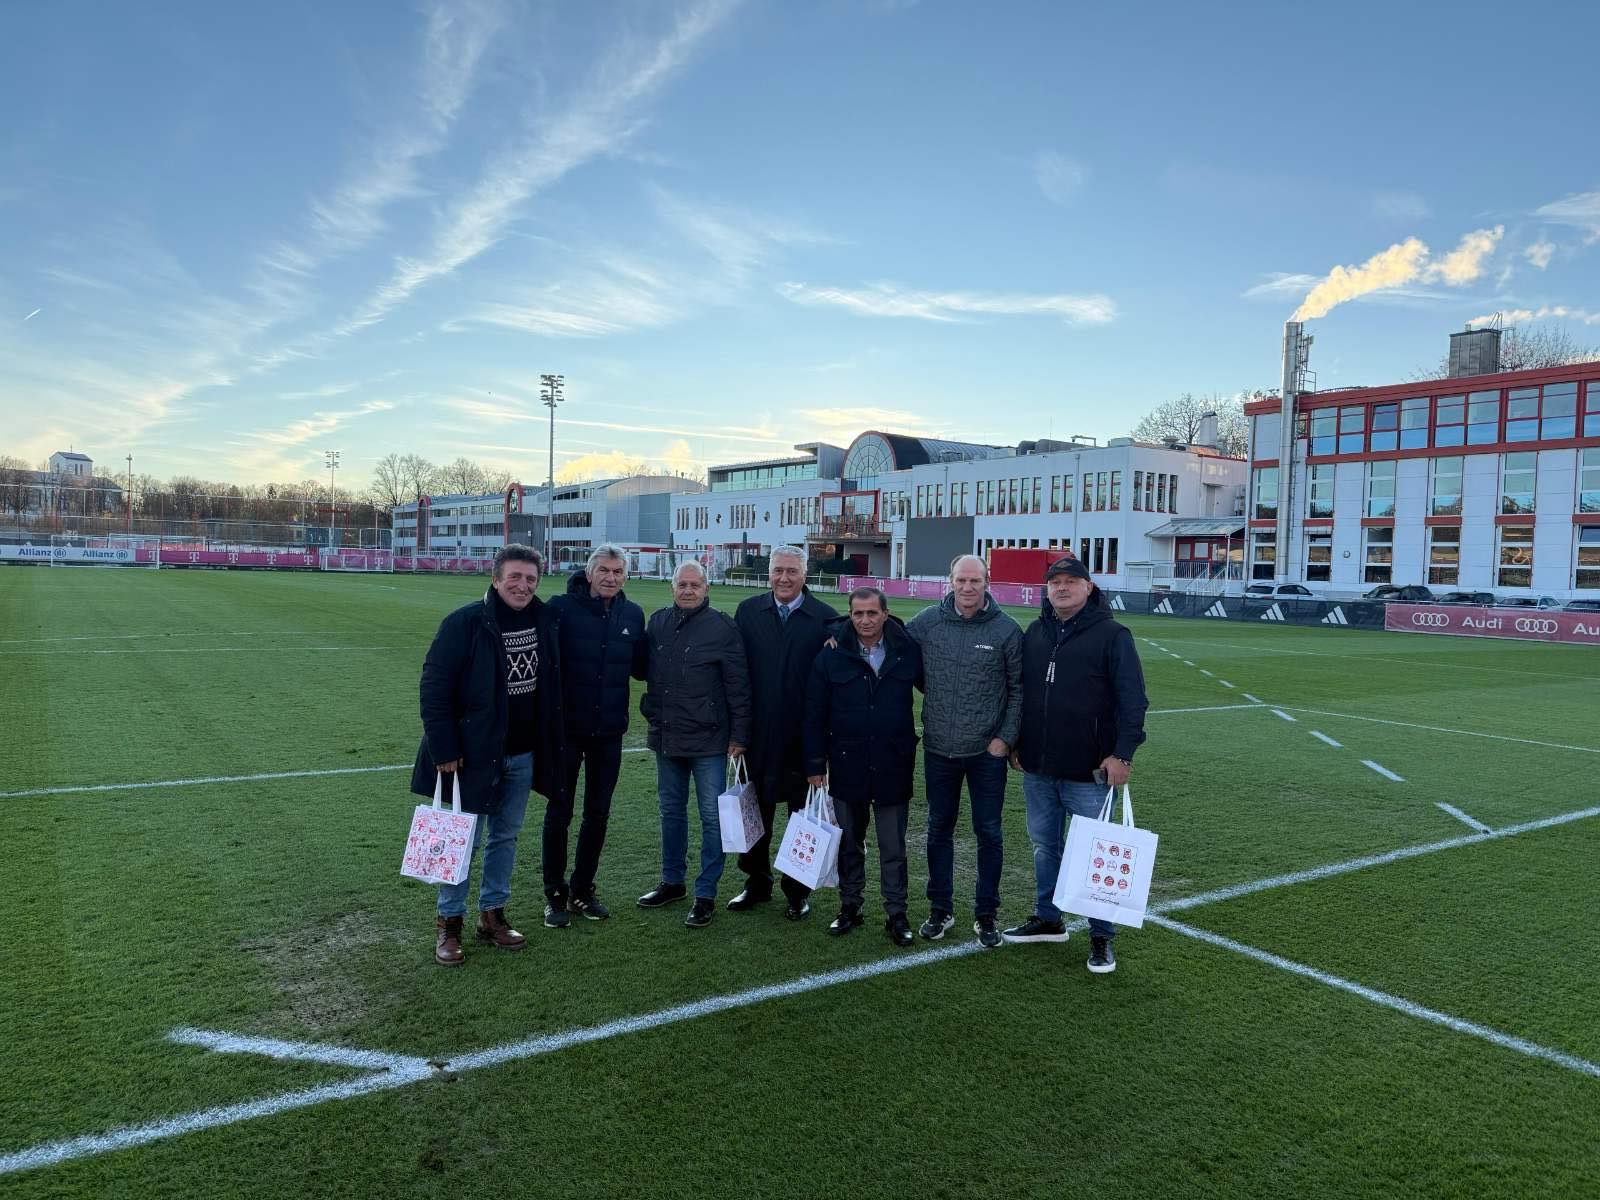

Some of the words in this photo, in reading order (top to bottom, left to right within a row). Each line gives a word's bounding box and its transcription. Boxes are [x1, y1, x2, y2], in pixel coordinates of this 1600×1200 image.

[18, 548, 51, 556] Allianz
[82, 549, 114, 558] Allianz
[189, 552, 199, 563] T
[229, 553, 238, 563] T
[267, 554, 276, 564] T
[303, 555, 313, 565] T
[847, 578, 855, 592] T
[909, 582, 917, 596] T
[1022, 588, 1032, 604] T
[1462, 617, 1502, 630] Audi
